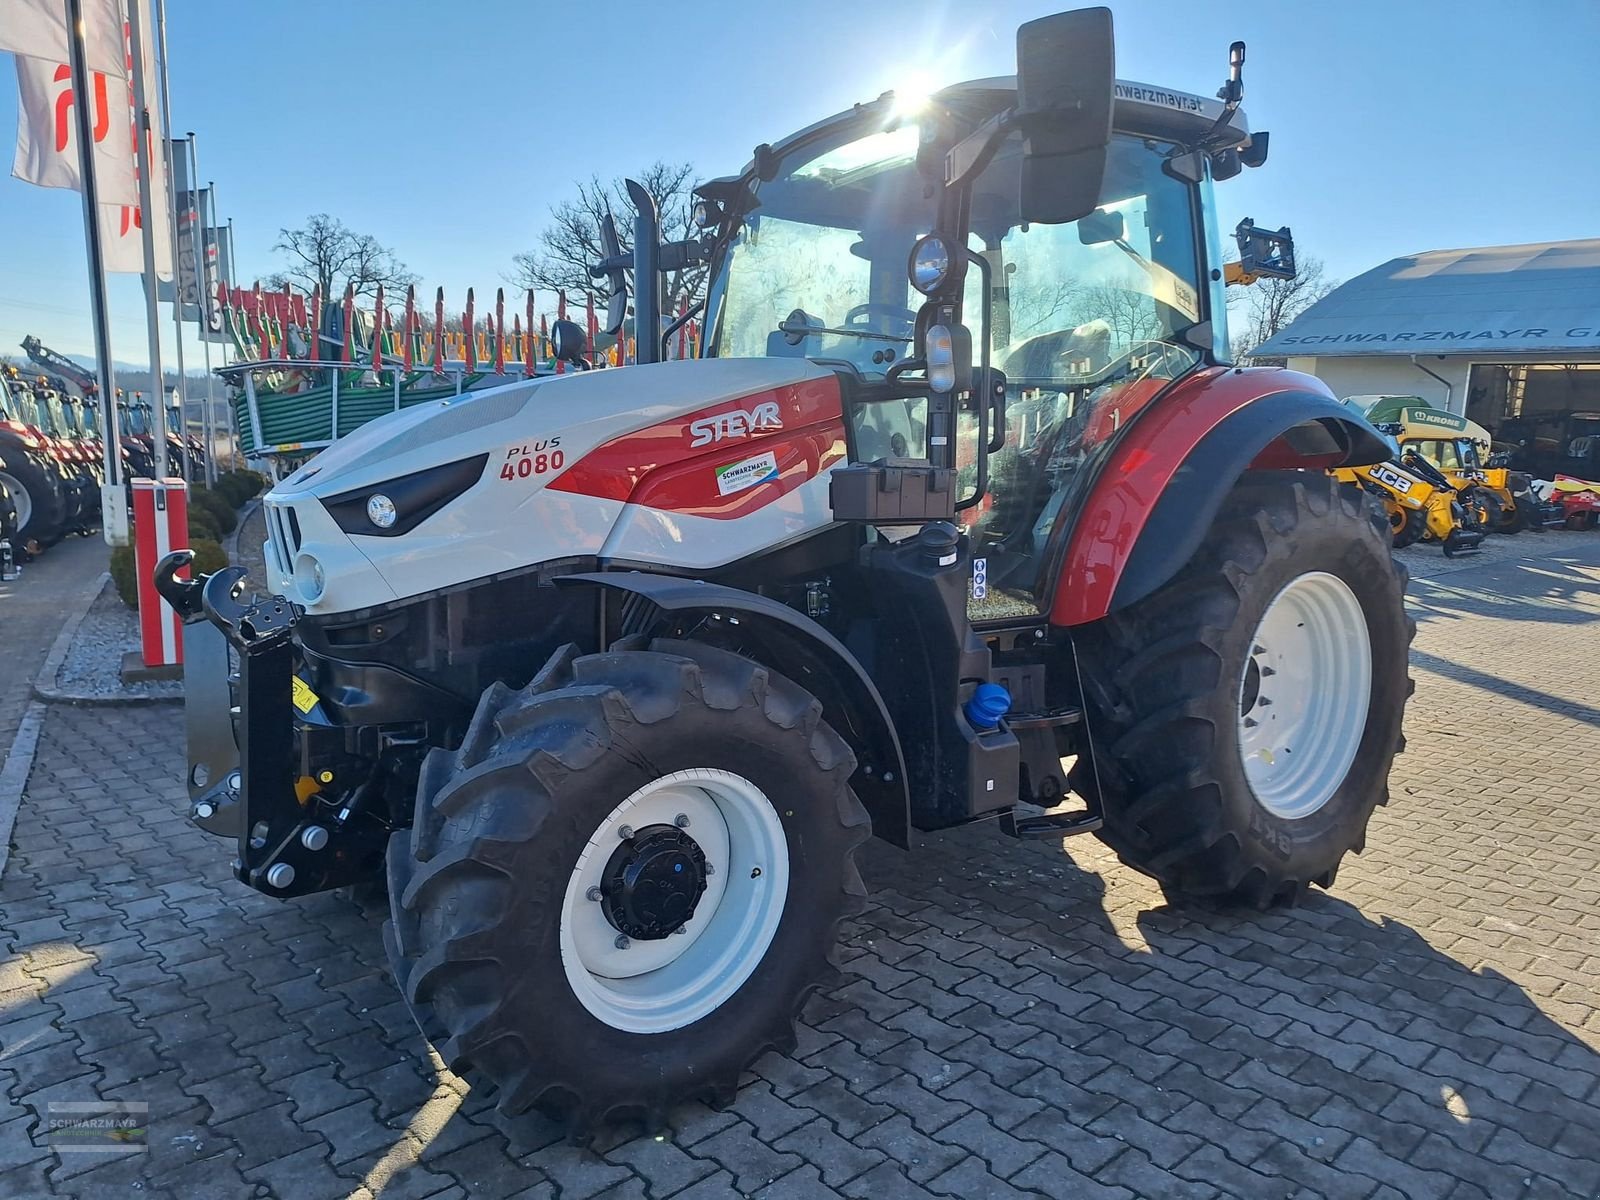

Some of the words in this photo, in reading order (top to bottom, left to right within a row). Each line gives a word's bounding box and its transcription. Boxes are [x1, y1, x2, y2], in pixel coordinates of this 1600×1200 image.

[1280, 328, 1549, 345] SCHWARZMAYR
[690, 401, 783, 448] STEYR
[1426, 415, 1460, 427] KRONE
[507, 436, 561, 459] PLUS
[500, 450, 564, 481] 4080
[722, 460, 768, 480] SCHWARZMAYR
[1369, 466, 1413, 493] JCB
